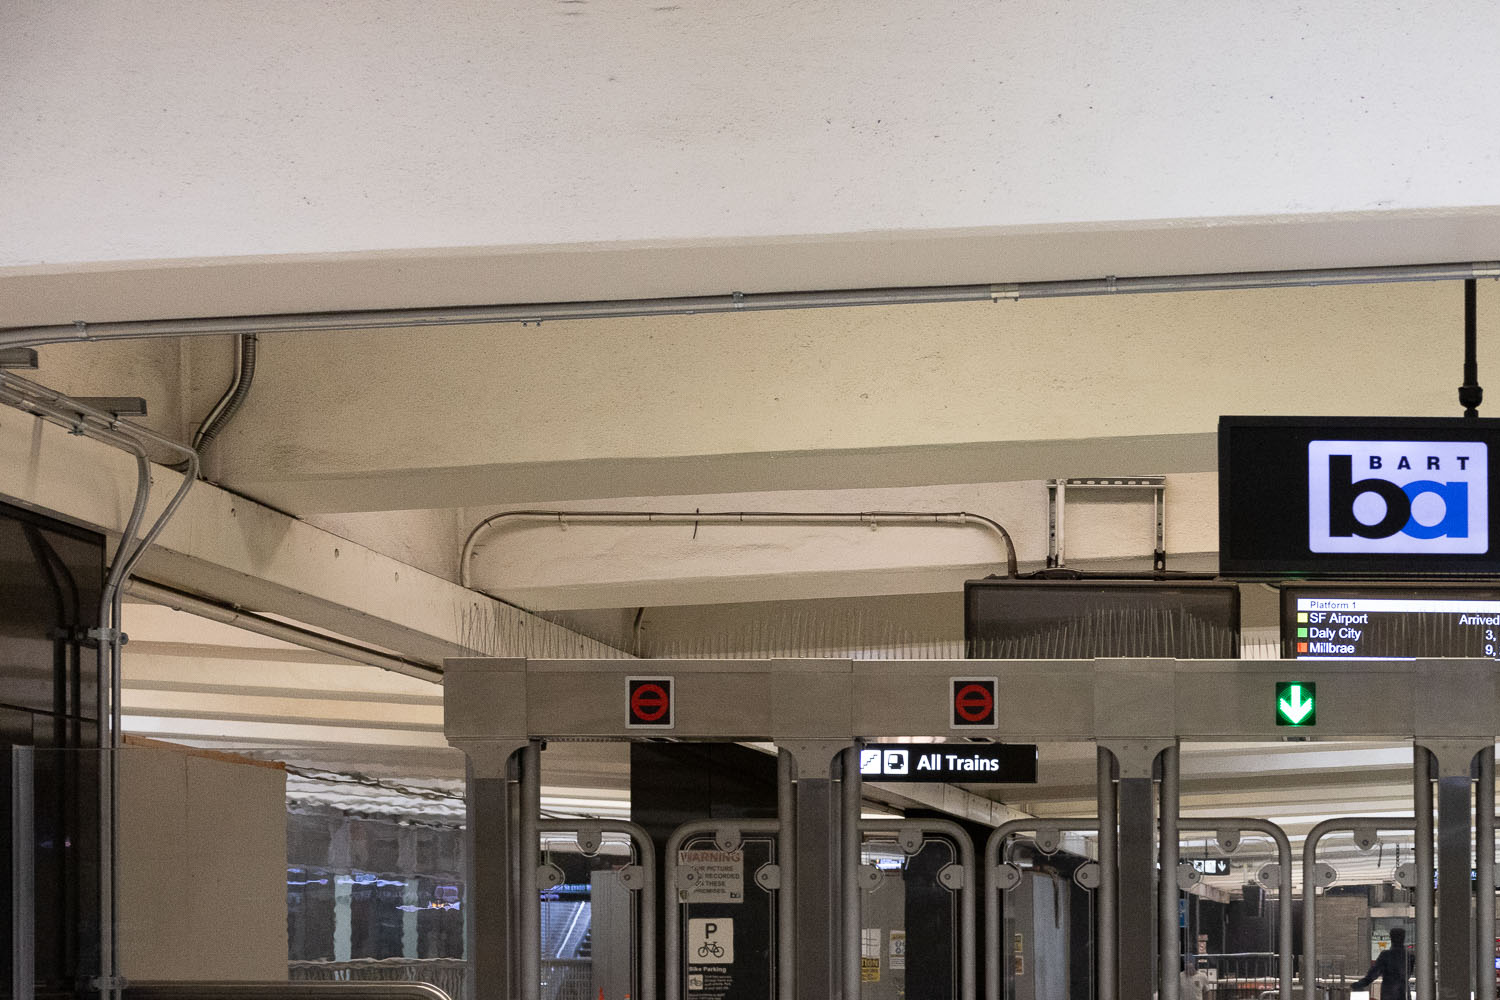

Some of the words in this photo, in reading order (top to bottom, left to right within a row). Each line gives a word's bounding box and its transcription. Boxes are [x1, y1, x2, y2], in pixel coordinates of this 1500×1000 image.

[1369, 456, 1469, 470] BART
[1310, 600, 1349, 610] Platform
[1352, 601, 1357, 609] 1
[1309, 613, 1326, 624] SF
[1329, 612, 1368, 626] Airport
[1309, 627, 1335, 640] Daly
[1337, 628, 1362, 640] City
[1485, 630, 1496, 642] 3,
[1309, 642, 1355, 654] Millbrae
[1485, 644, 1496, 656] 9,
[916, 755, 941, 772] All
[945, 755, 1000, 772] Trains
[705, 923, 717, 939] P
